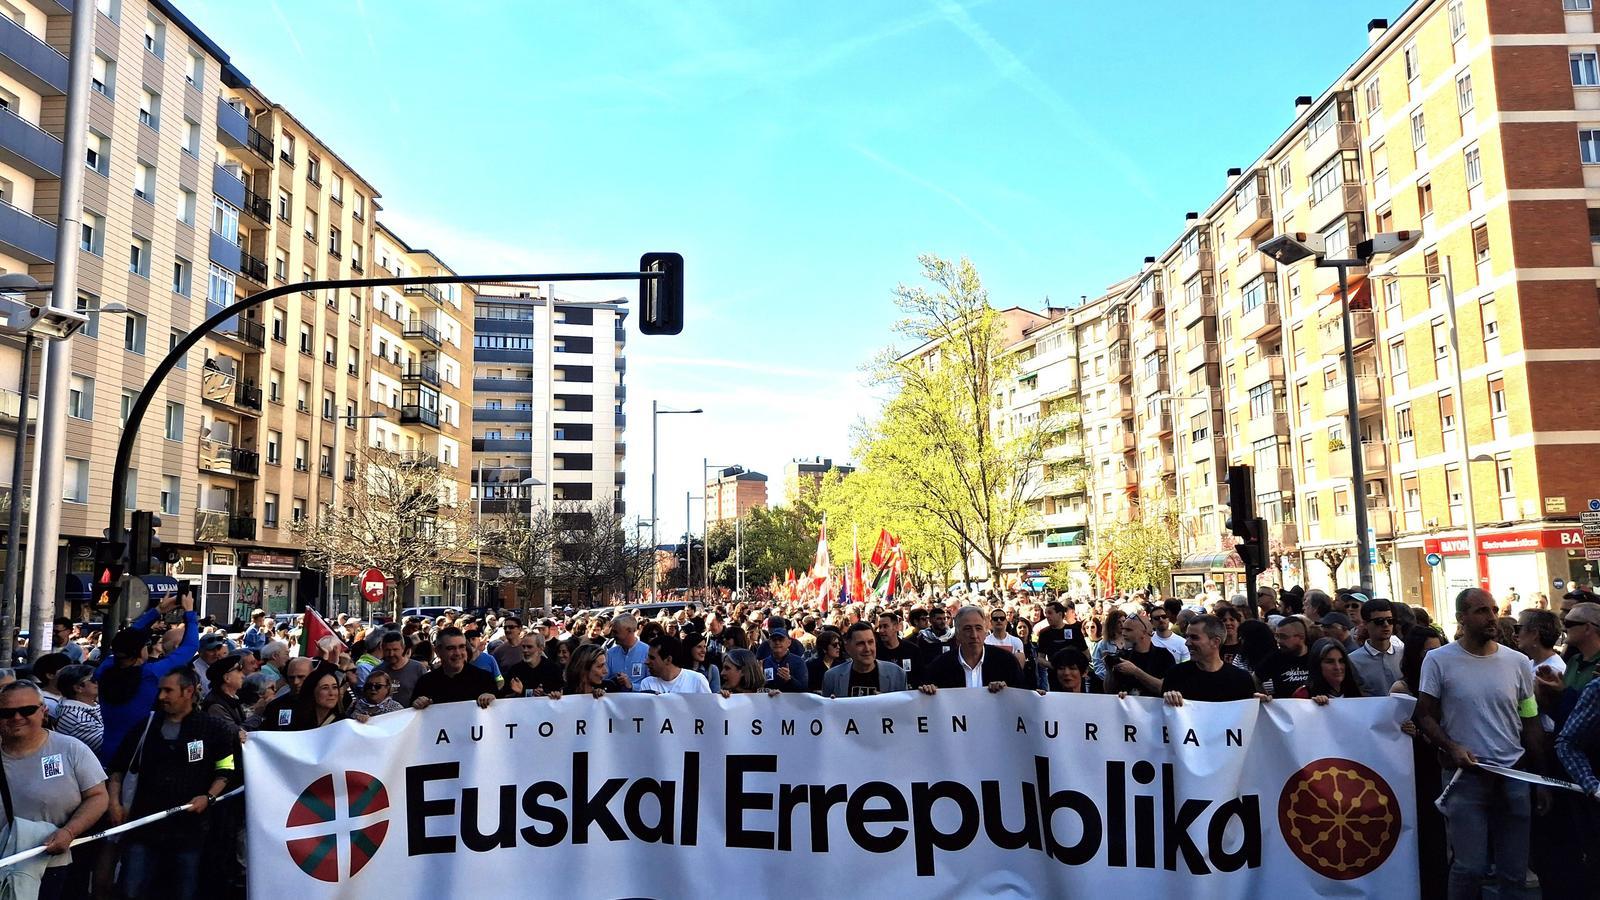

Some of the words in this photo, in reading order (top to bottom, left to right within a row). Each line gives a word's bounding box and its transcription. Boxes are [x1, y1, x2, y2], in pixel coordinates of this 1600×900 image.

[1560, 533, 1582, 544] BA
[435, 715, 968, 745] AUTORITARISMOAREN
[1016, 716, 1243, 747] AURREAN
[405, 751, 700, 857] Euskal
[725, 755, 1262, 876] Errepublika
